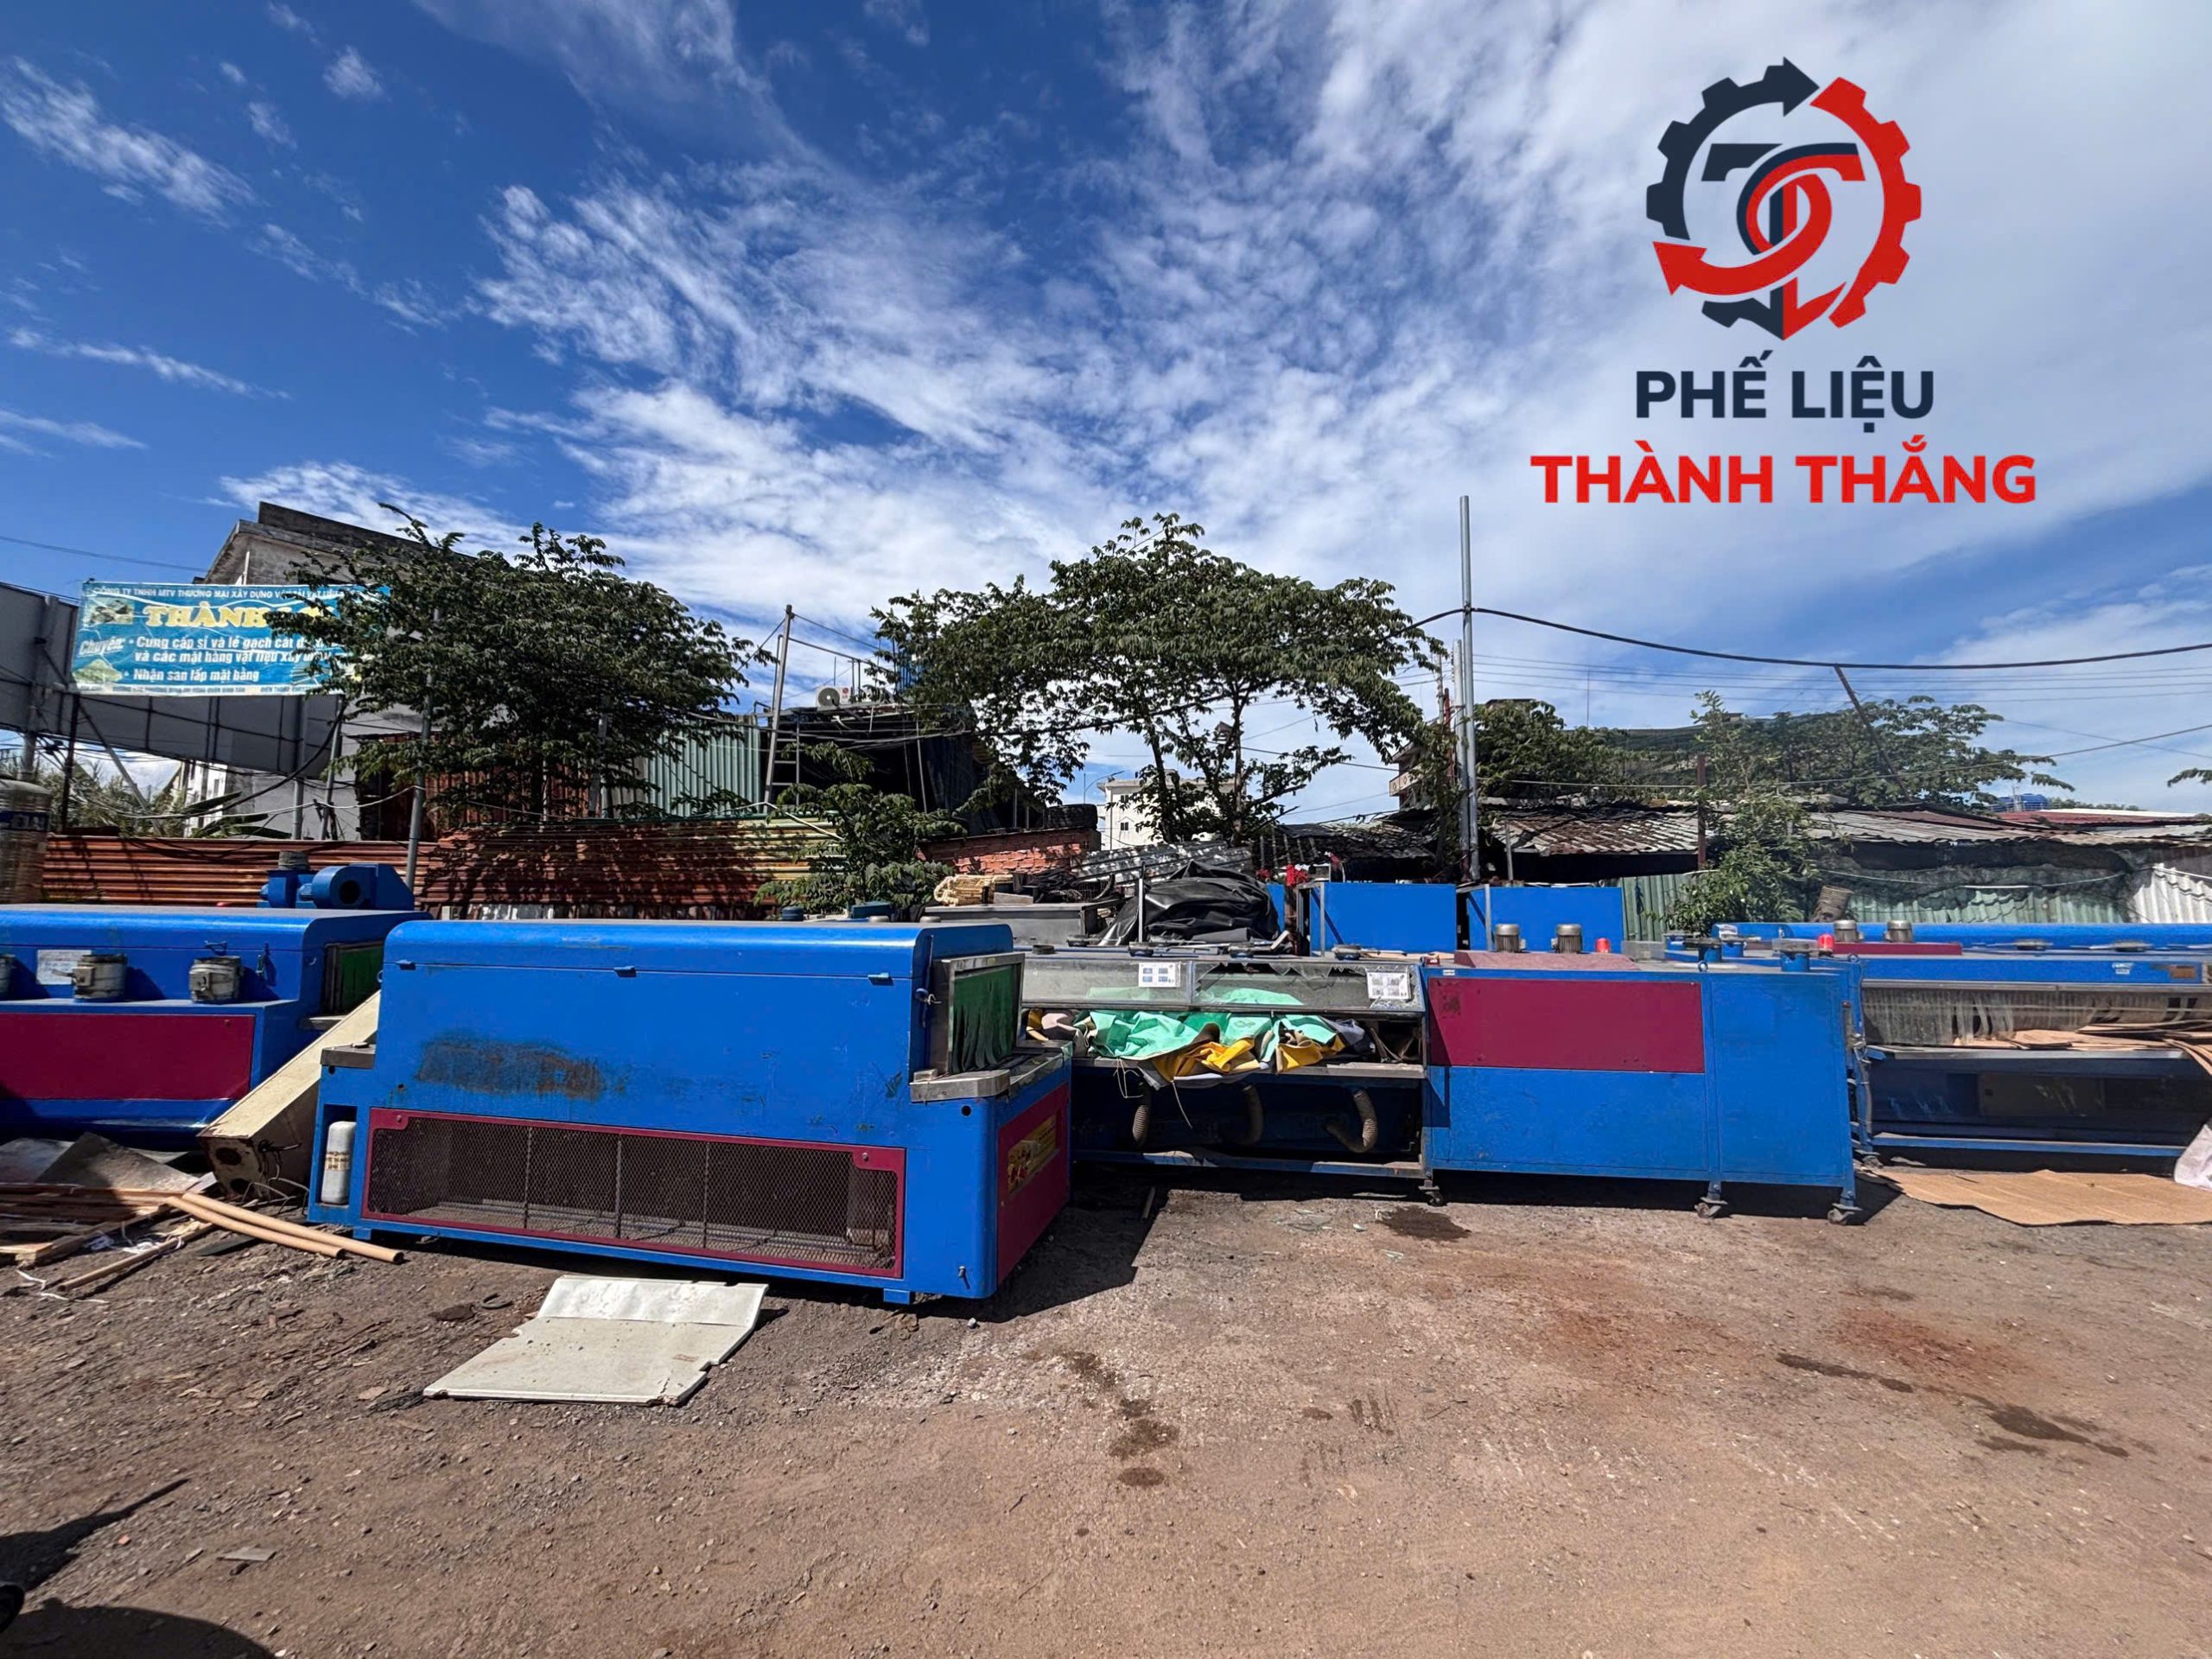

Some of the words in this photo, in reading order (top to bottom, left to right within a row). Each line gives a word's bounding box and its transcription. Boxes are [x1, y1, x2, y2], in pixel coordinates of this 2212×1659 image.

[136, 636, 168, 650] Cung
[135, 650, 150, 662] và
[133, 668, 164, 683] Nhận
[167, 670, 188, 681] san
